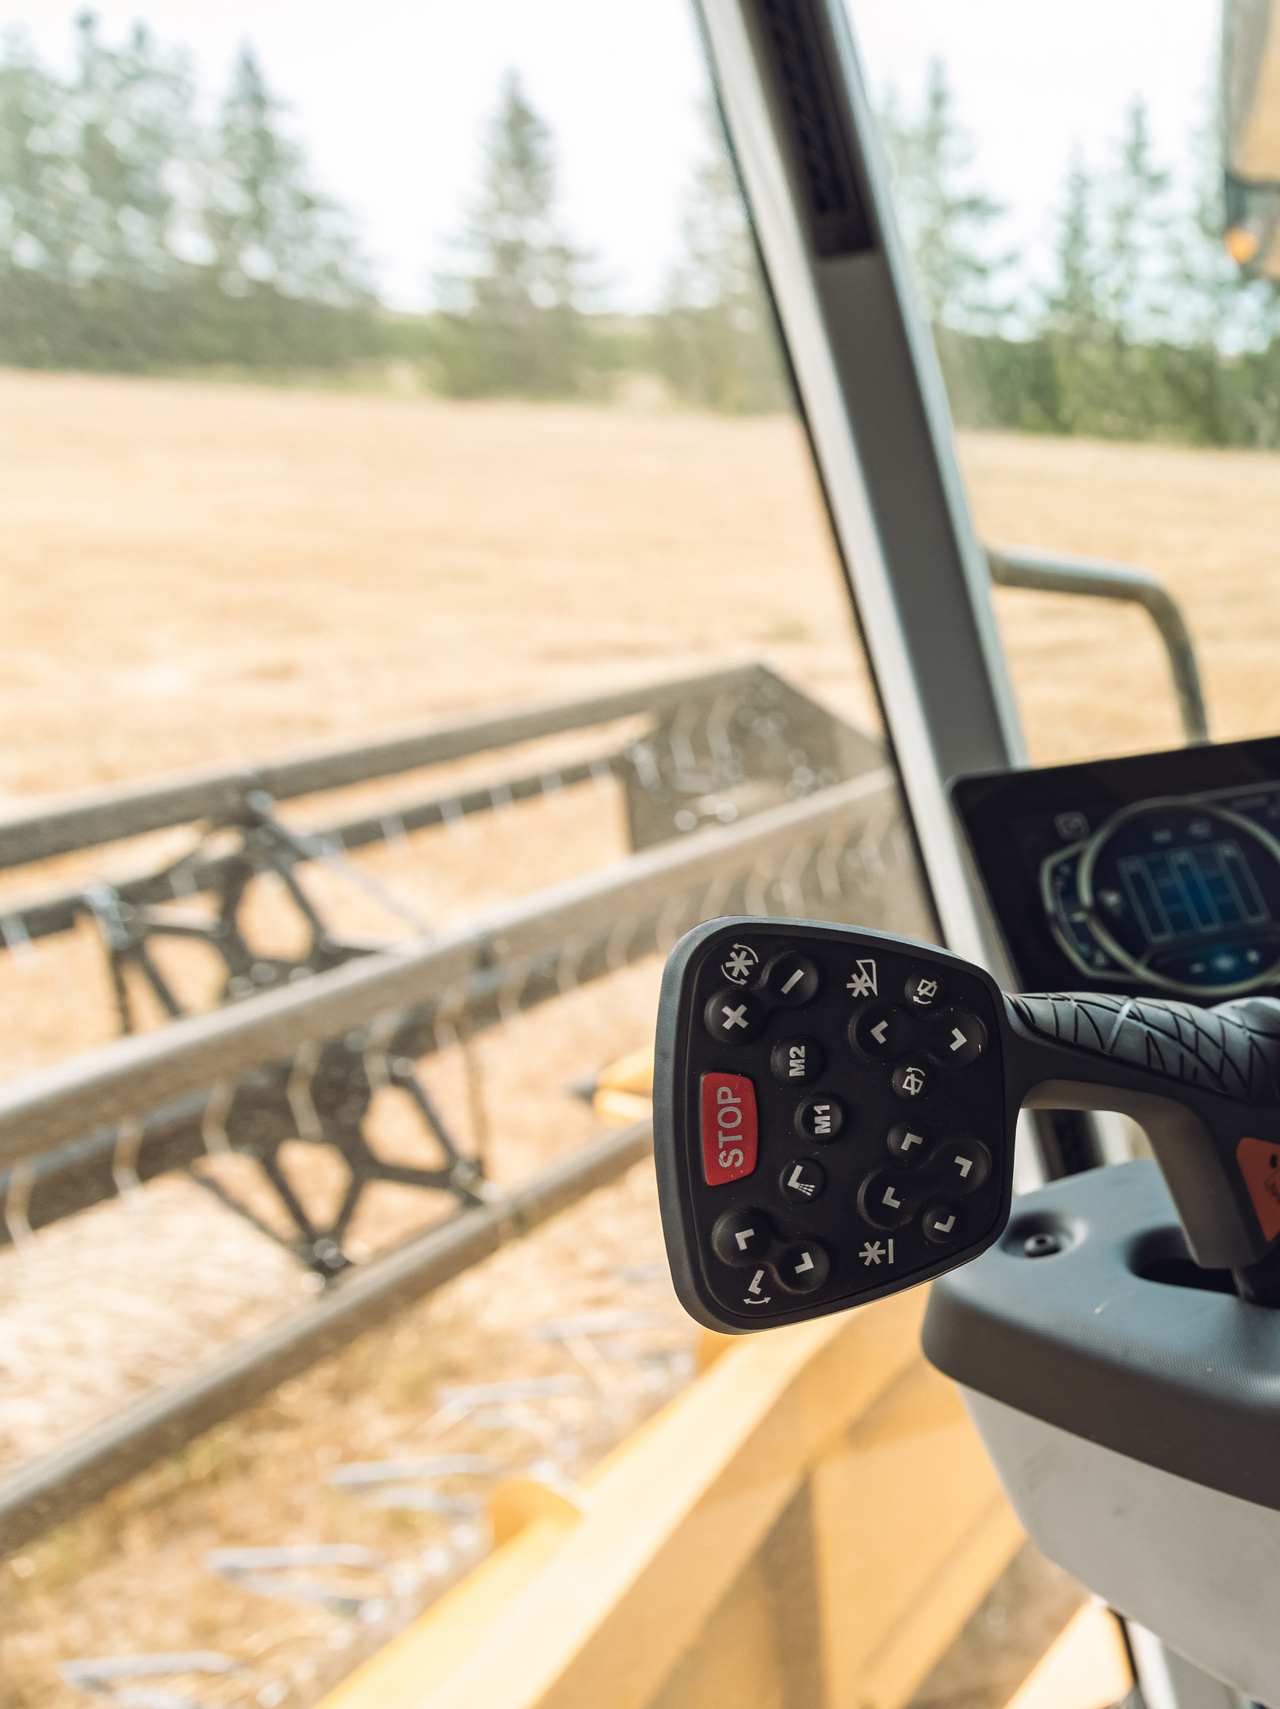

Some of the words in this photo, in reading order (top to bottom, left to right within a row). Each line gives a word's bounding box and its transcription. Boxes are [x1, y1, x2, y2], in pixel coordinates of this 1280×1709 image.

[789, 1045, 806, 1077] M2
[717, 1086, 744, 1168] STOP
[813, 1104, 831, 1134] M1
